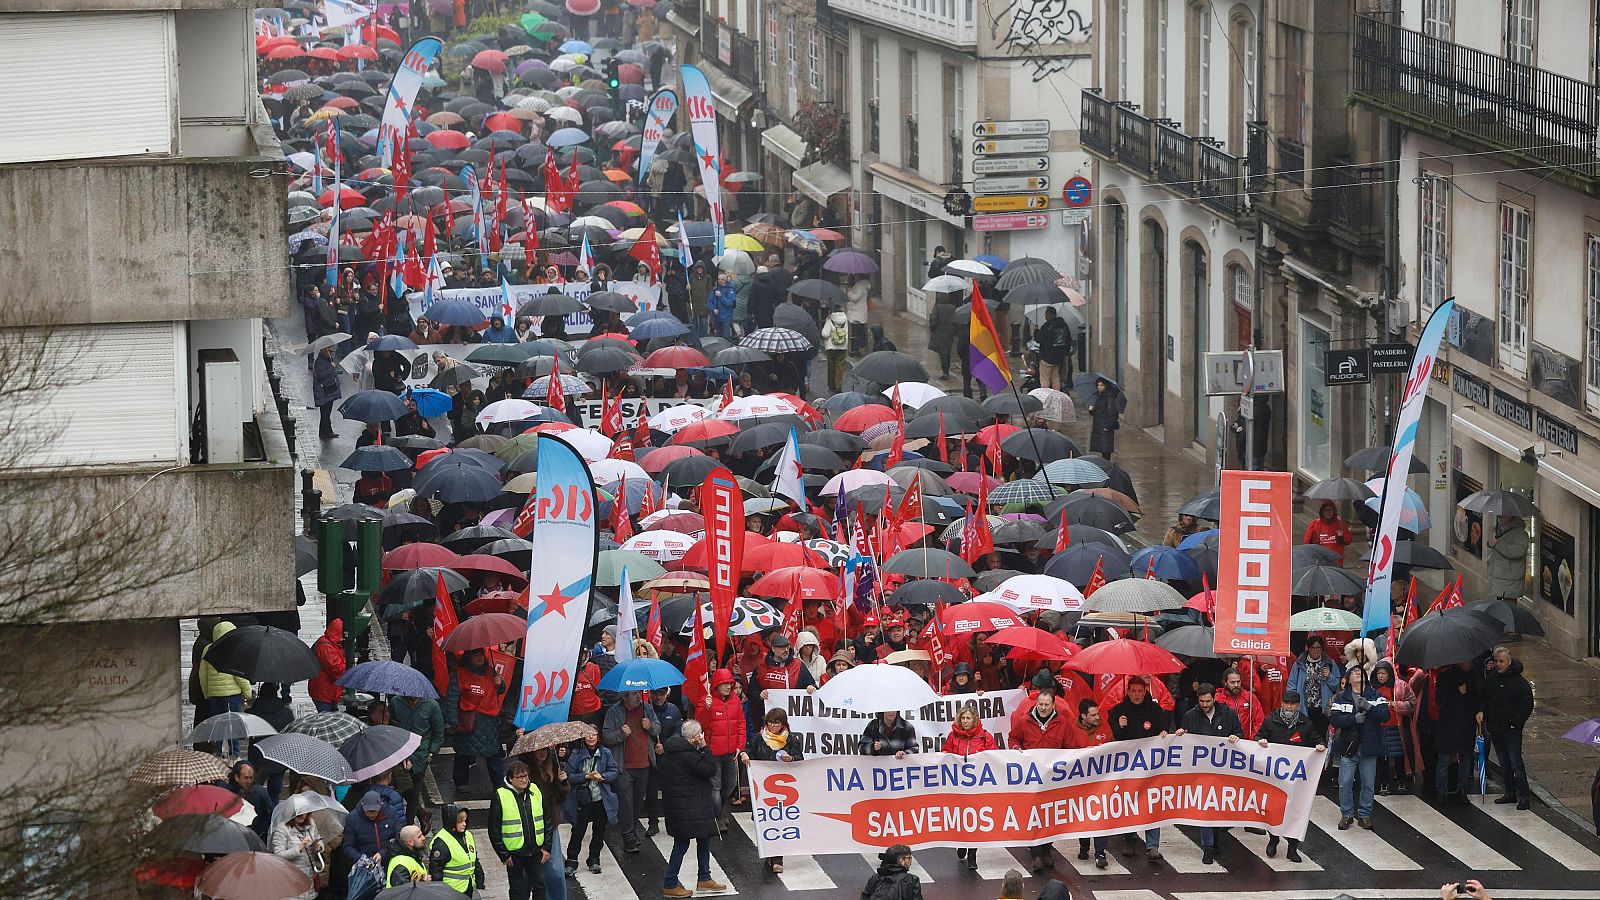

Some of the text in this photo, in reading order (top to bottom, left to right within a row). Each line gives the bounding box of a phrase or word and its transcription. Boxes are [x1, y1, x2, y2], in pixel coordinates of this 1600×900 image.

[687, 96, 714, 119] CIG
[1373, 348, 1407, 356] PANADERIA
[1372, 360, 1408, 368] PASTELERIA
[1236, 479, 1271, 623] CCOO
[956, 621, 979, 629] CCOO
[1231, 638, 1271, 650] Galicia
[788, 695, 813, 717] NA
[826, 742, 1307, 792] NA DEFENSA DA SANIDADE PÚBLICA
[867, 784, 1269, 838] SALVEMOS A ATENCIÓN PRIMARIA!
[762, 826, 801, 841] ca
